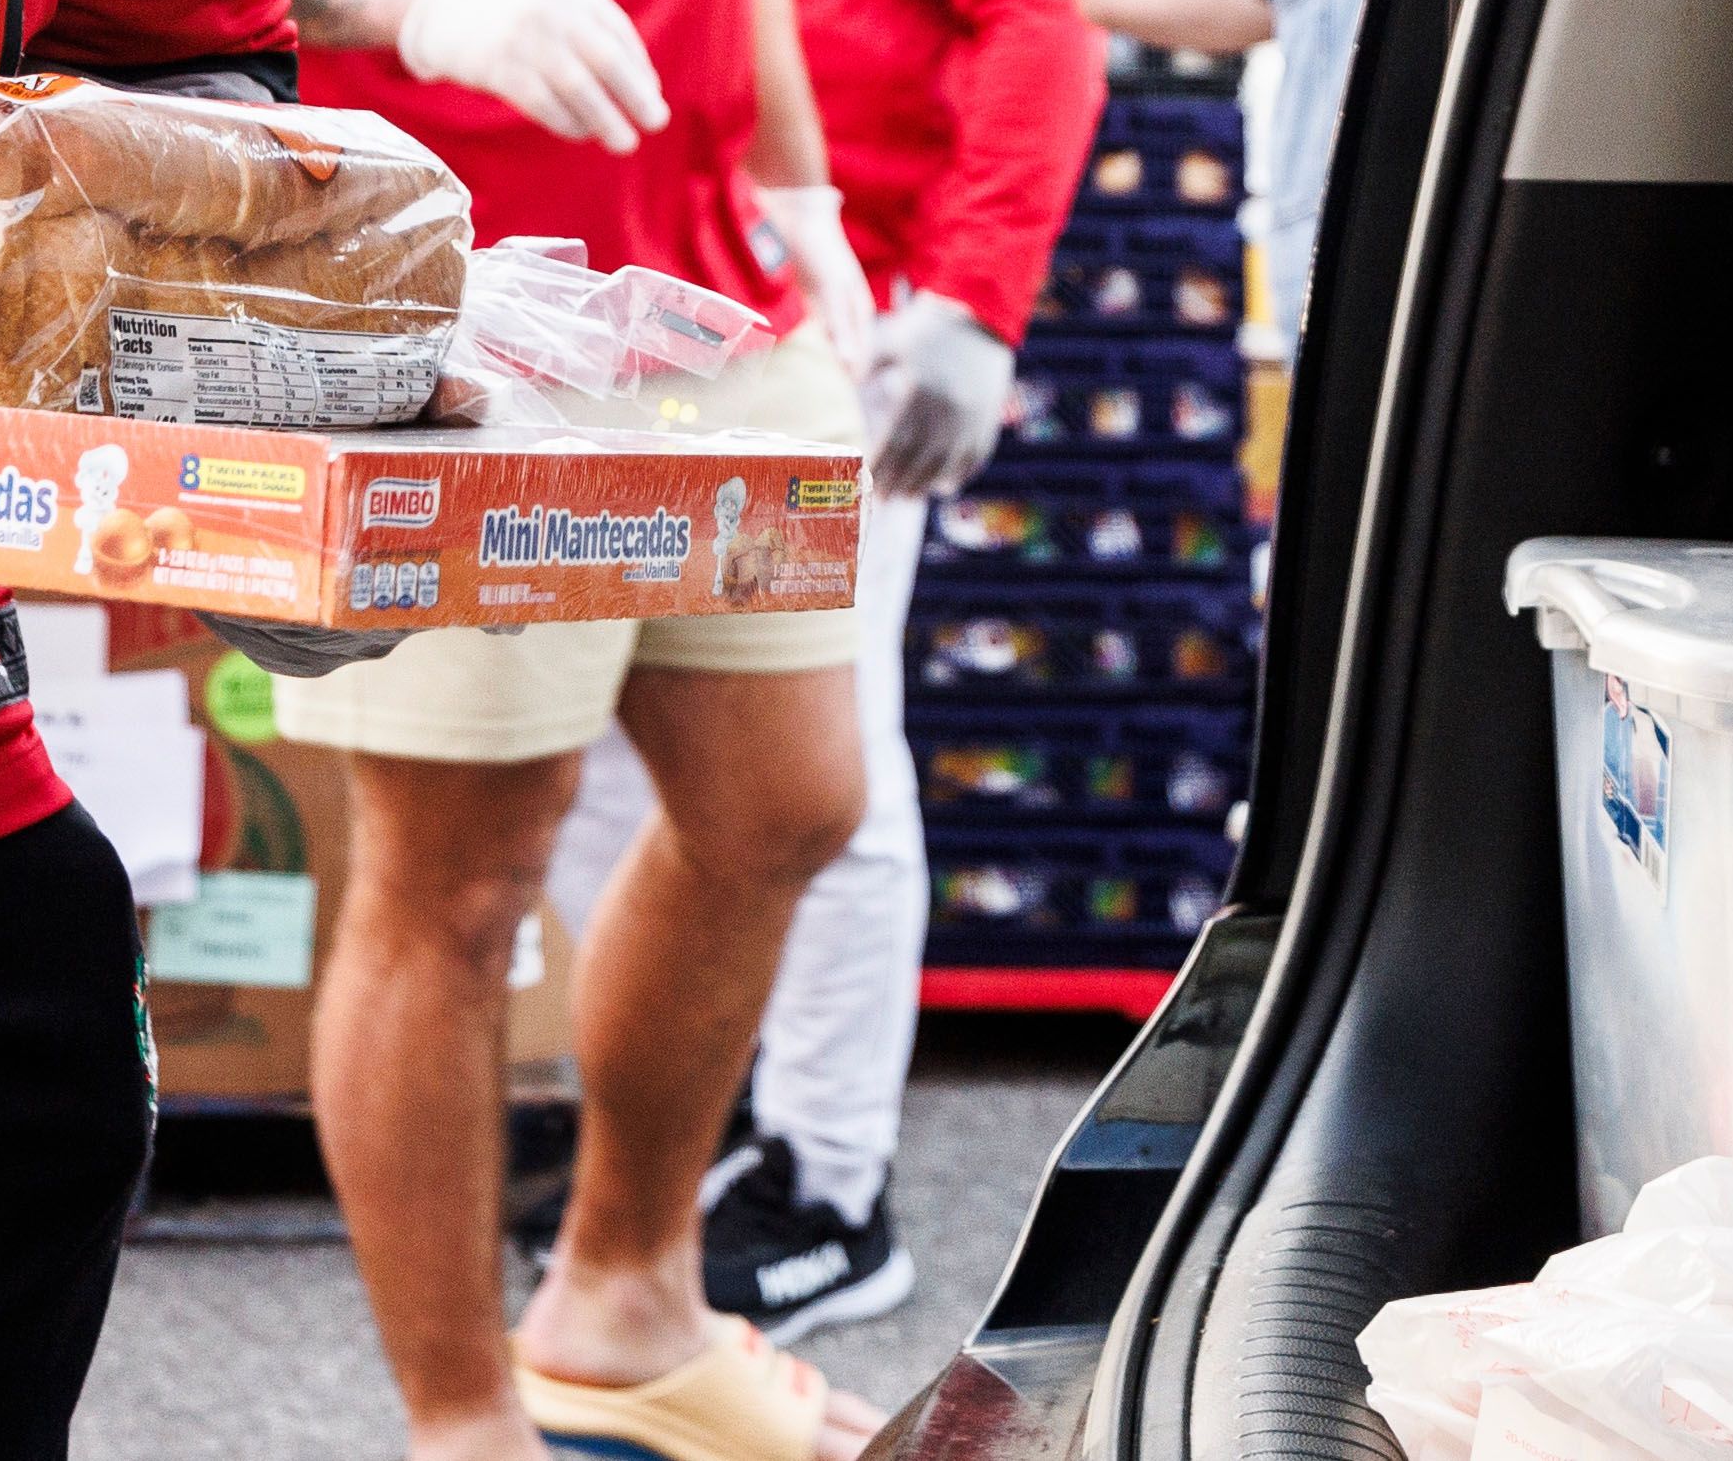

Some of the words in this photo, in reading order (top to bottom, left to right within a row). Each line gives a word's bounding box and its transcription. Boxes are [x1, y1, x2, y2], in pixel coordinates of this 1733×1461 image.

[113, 315, 177, 338] Nutrition
[179, 453, 201, 490] 8
[369, 490, 434, 515] BIMBO
[787, 475, 801, 510] 8
[482, 508, 541, 562] Mini
[544, 508, 689, 562] Mantecadas
[644, 559, 680, 579] Vainilla
